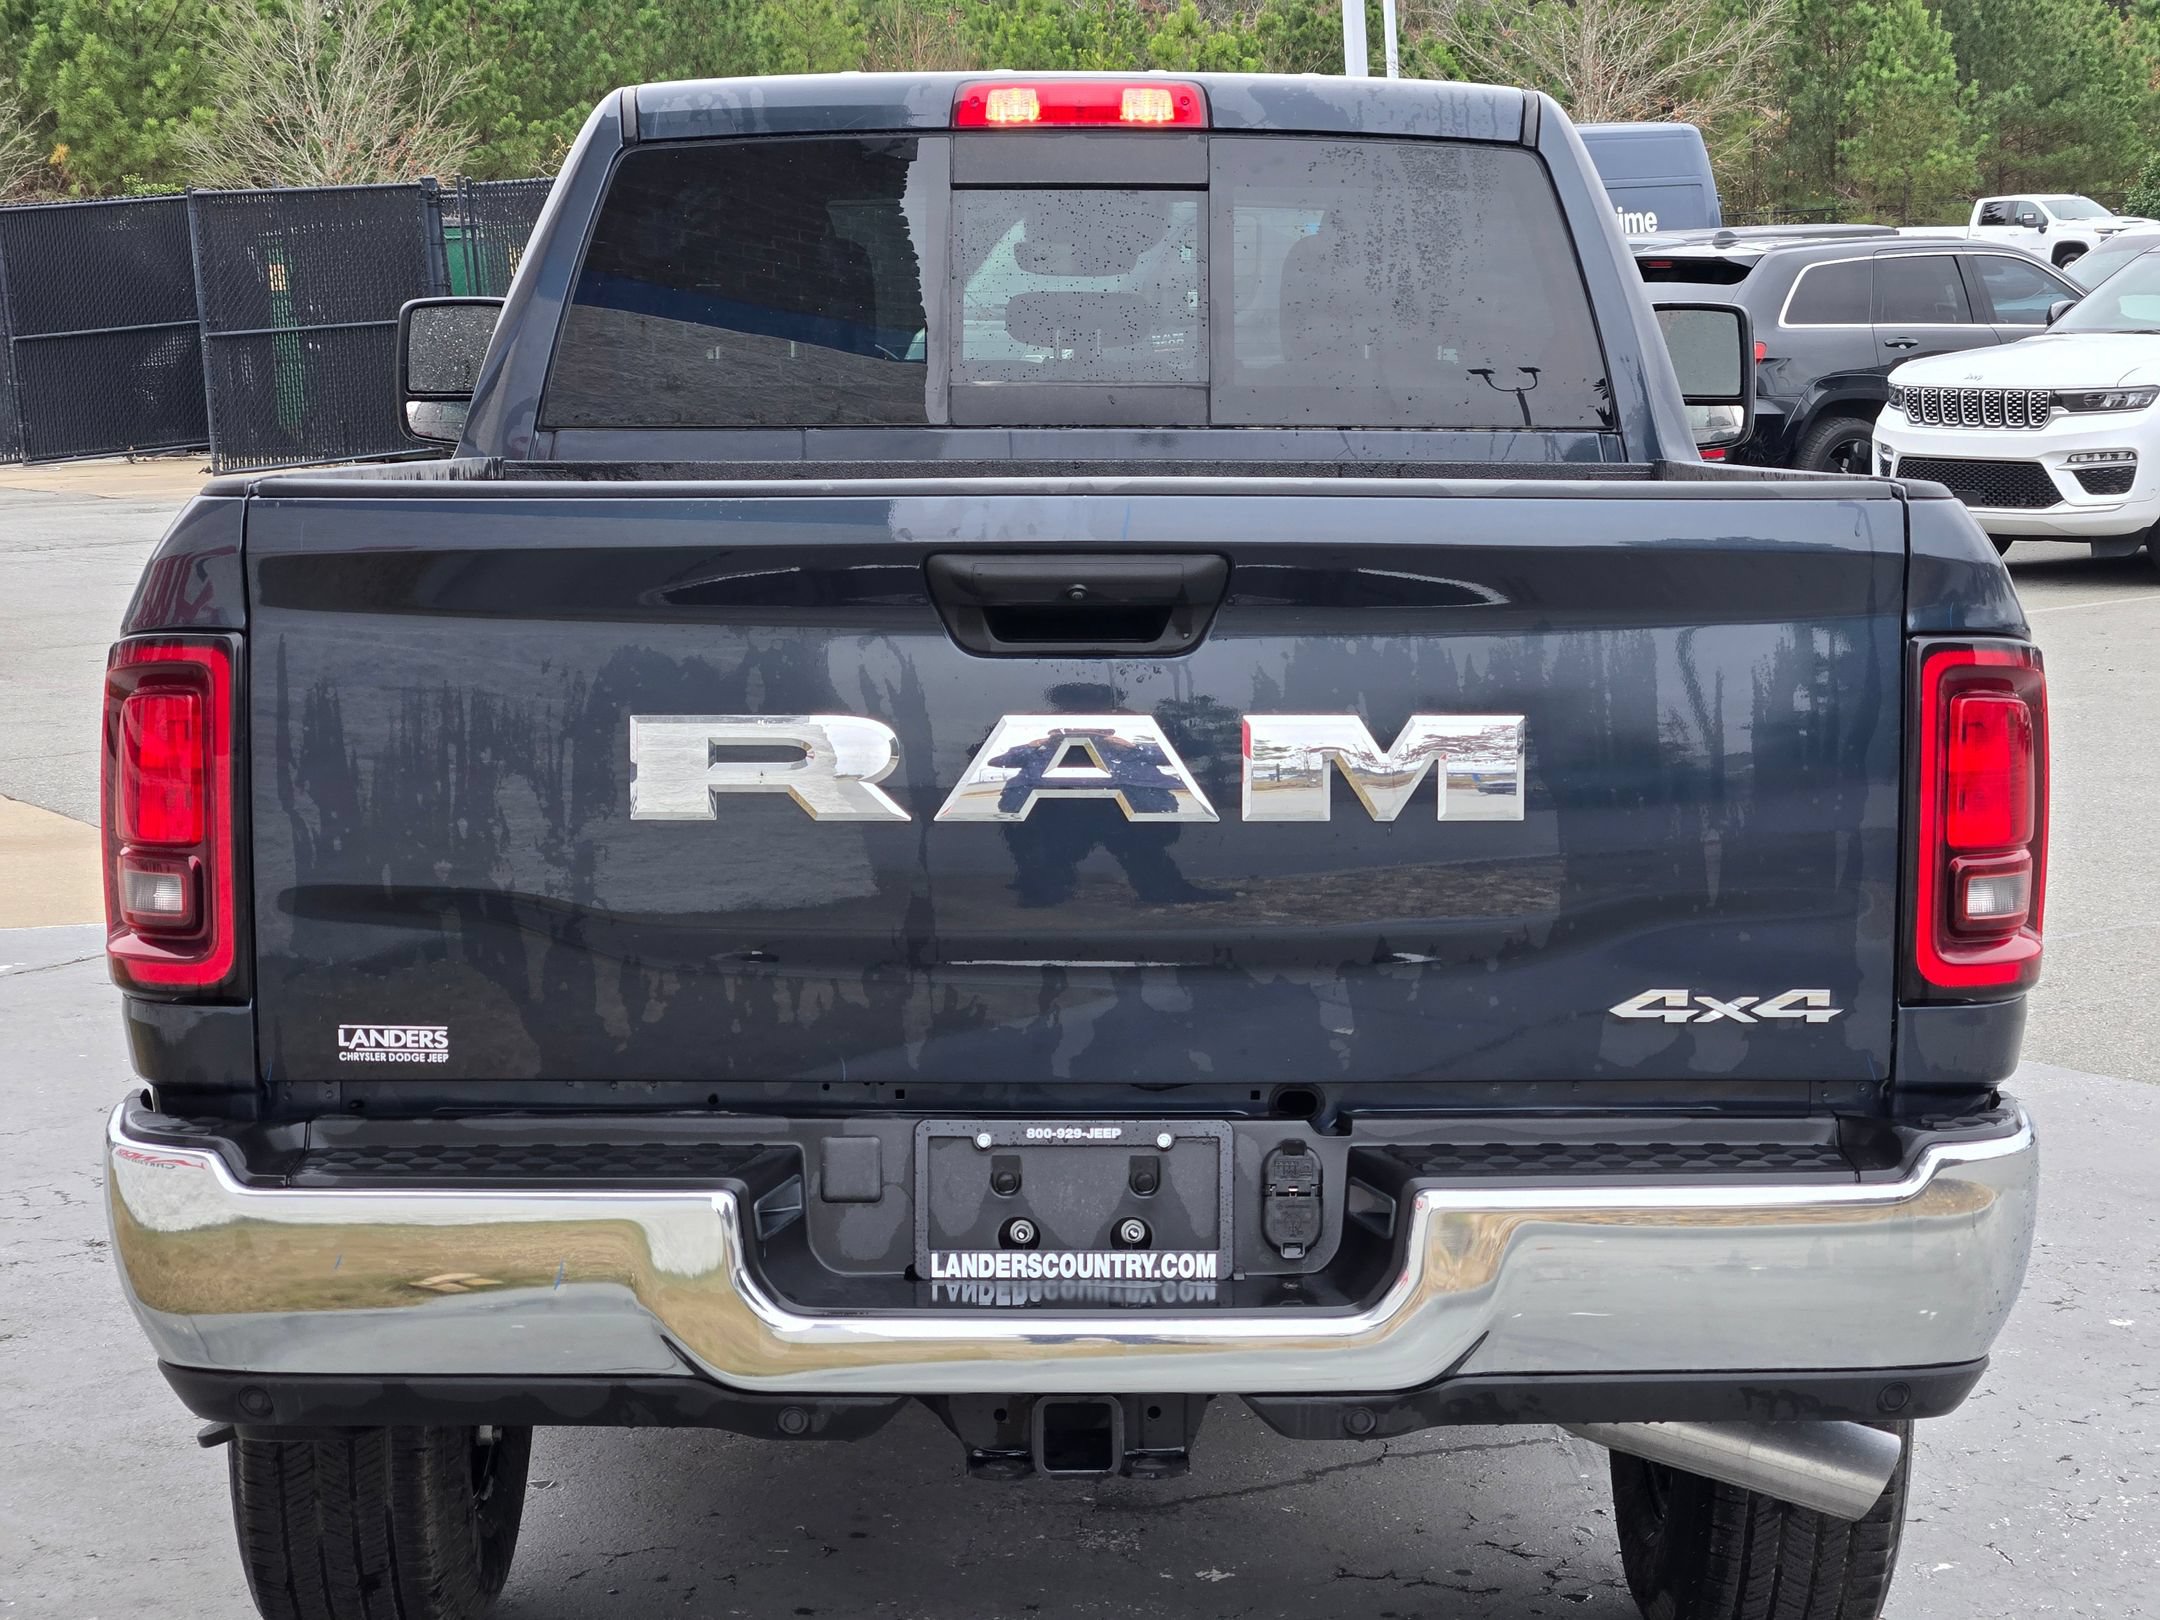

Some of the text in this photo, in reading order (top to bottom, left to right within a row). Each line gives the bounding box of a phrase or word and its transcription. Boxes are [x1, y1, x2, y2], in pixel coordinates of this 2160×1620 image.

[629, 714, 1526, 822] RAM
[338, 1029, 449, 1049] LANDERS
[338, 1051, 449, 1063] CHRYSLER DODGE JEEP
[1026, 1127, 1122, 1139] 800-929-JEEP
[931, 1253, 1217, 1279] LANDERSCOUNTRY.COM
